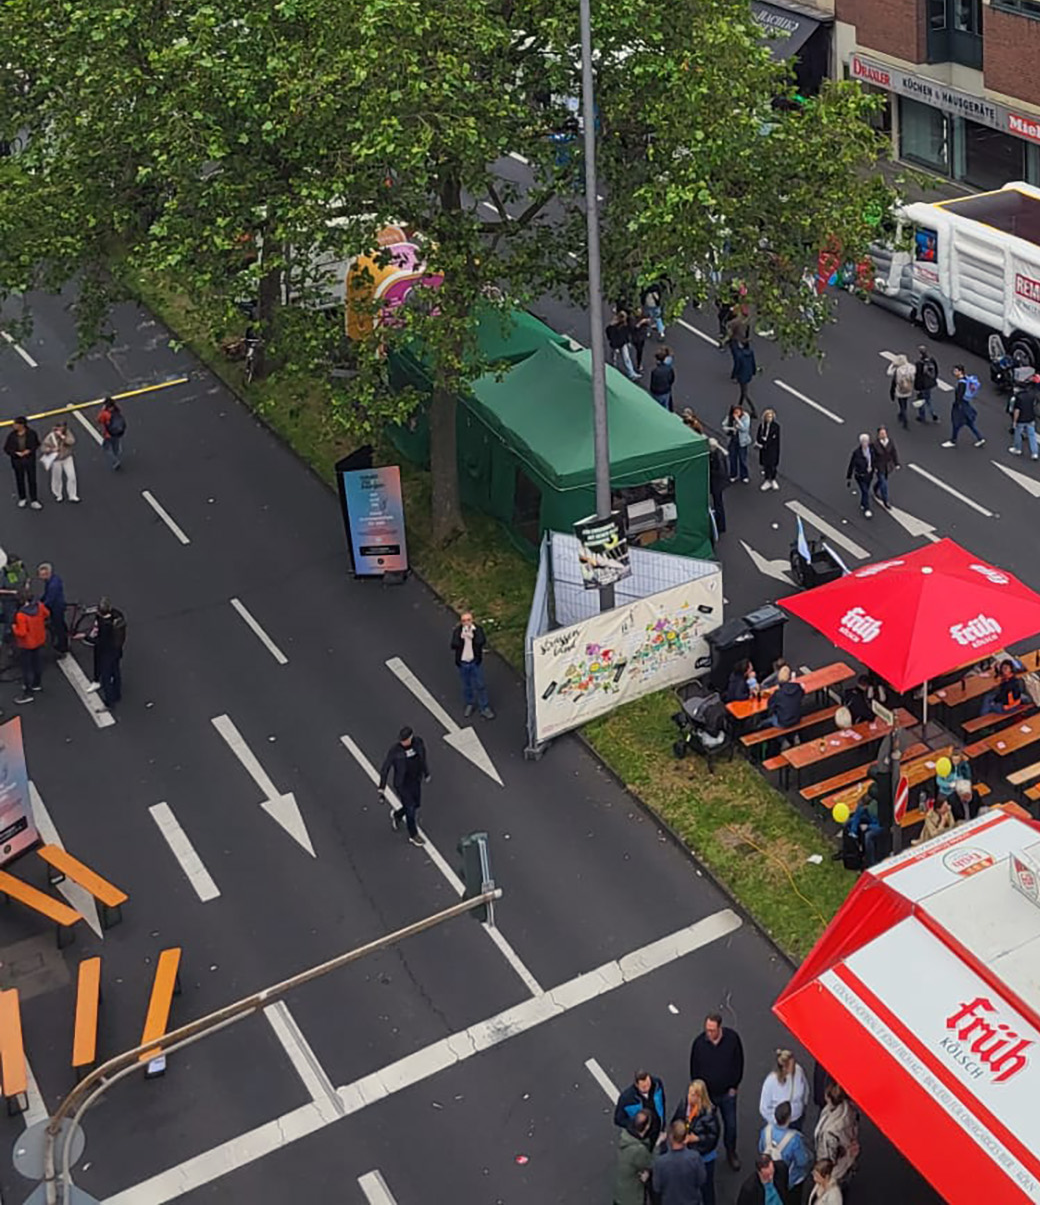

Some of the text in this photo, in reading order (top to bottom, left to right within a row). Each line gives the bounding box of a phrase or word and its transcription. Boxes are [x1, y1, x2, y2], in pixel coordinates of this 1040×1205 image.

[903, 78, 933, 98] KÜCHEN
[942, 92, 995, 120] HAUSGERÄTE
[940, 1037, 985, 1079] KÖLSCH
